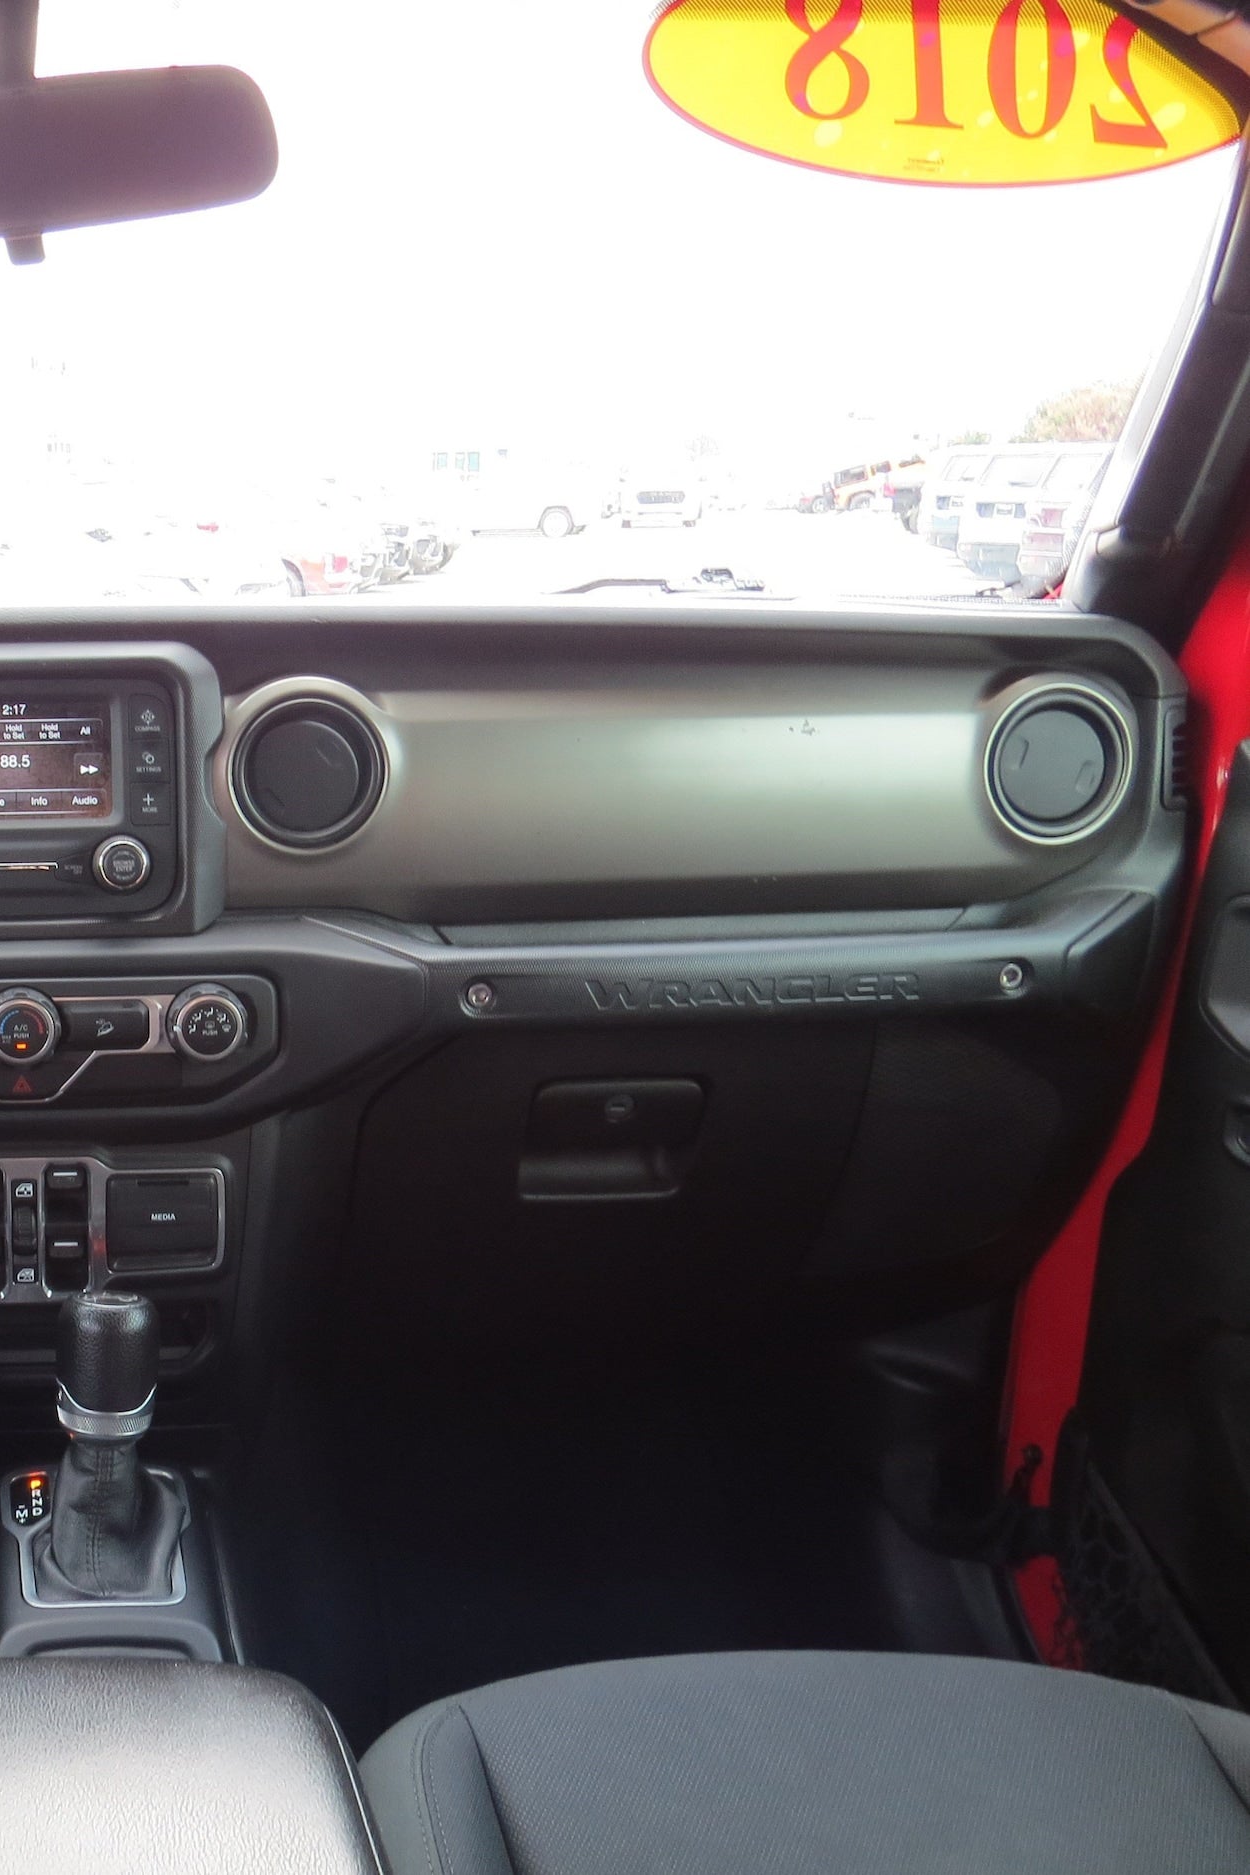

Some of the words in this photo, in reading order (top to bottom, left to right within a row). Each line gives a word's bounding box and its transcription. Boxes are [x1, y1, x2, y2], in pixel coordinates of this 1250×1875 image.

[2, 704, 26, 716] 2:17
[5, 724, 23, 732] Hold
[41, 723, 59, 732] Hold
[80, 726, 91, 736] All
[3, 732, 12, 740] to
[13, 731, 25, 740] Set
[39, 731, 48, 739] to
[48, 731, 60, 739] Set
[0, 755, 30, 768] 88.5
[31, 796, 48, 806] Info
[72, 795, 98, 806] Audio
[584, 973, 920, 1011] WRANGLER
[13, 1024, 28, 1032] A/C
[151, 1213, 176, 1221] MEDIA
[30, 1480, 41, 1489] P
[31, 1489, 41, 1498] R
[32, 1497, 43, 1507] N
[15, 1509, 29, 1519] M
[32, 1507, 43, 1517] D
